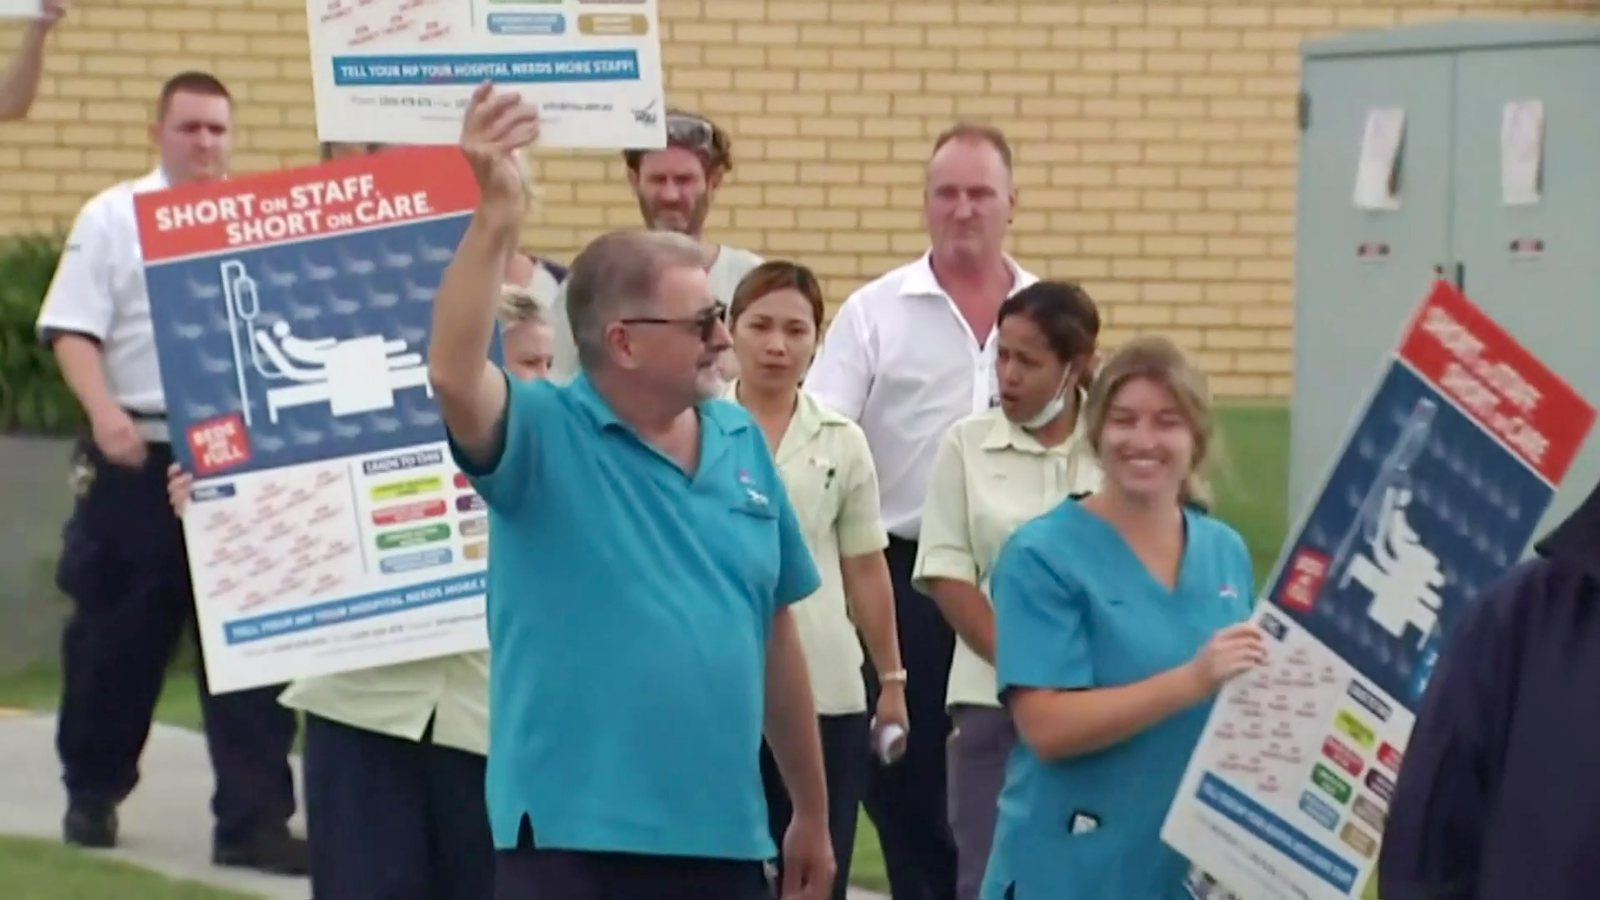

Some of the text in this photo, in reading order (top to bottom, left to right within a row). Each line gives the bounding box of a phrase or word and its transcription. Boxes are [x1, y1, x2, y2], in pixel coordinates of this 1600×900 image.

[341, 65, 367, 78] TELL
[369, 64, 400, 77] YOUR
[420, 64, 453, 77] YOUR
[454, 62, 510, 77] HOSPITAL
[512, 61, 552, 75] NEEDS
[555, 60, 591, 74] MORE
[155, 194, 255, 231] SHORT
[260, 197, 288, 213] ON
[226, 212, 323, 245] SHORT
[326, 213, 354, 229] ON
[193, 421, 236, 446] BEDS
[203, 445, 243, 468] FULL
